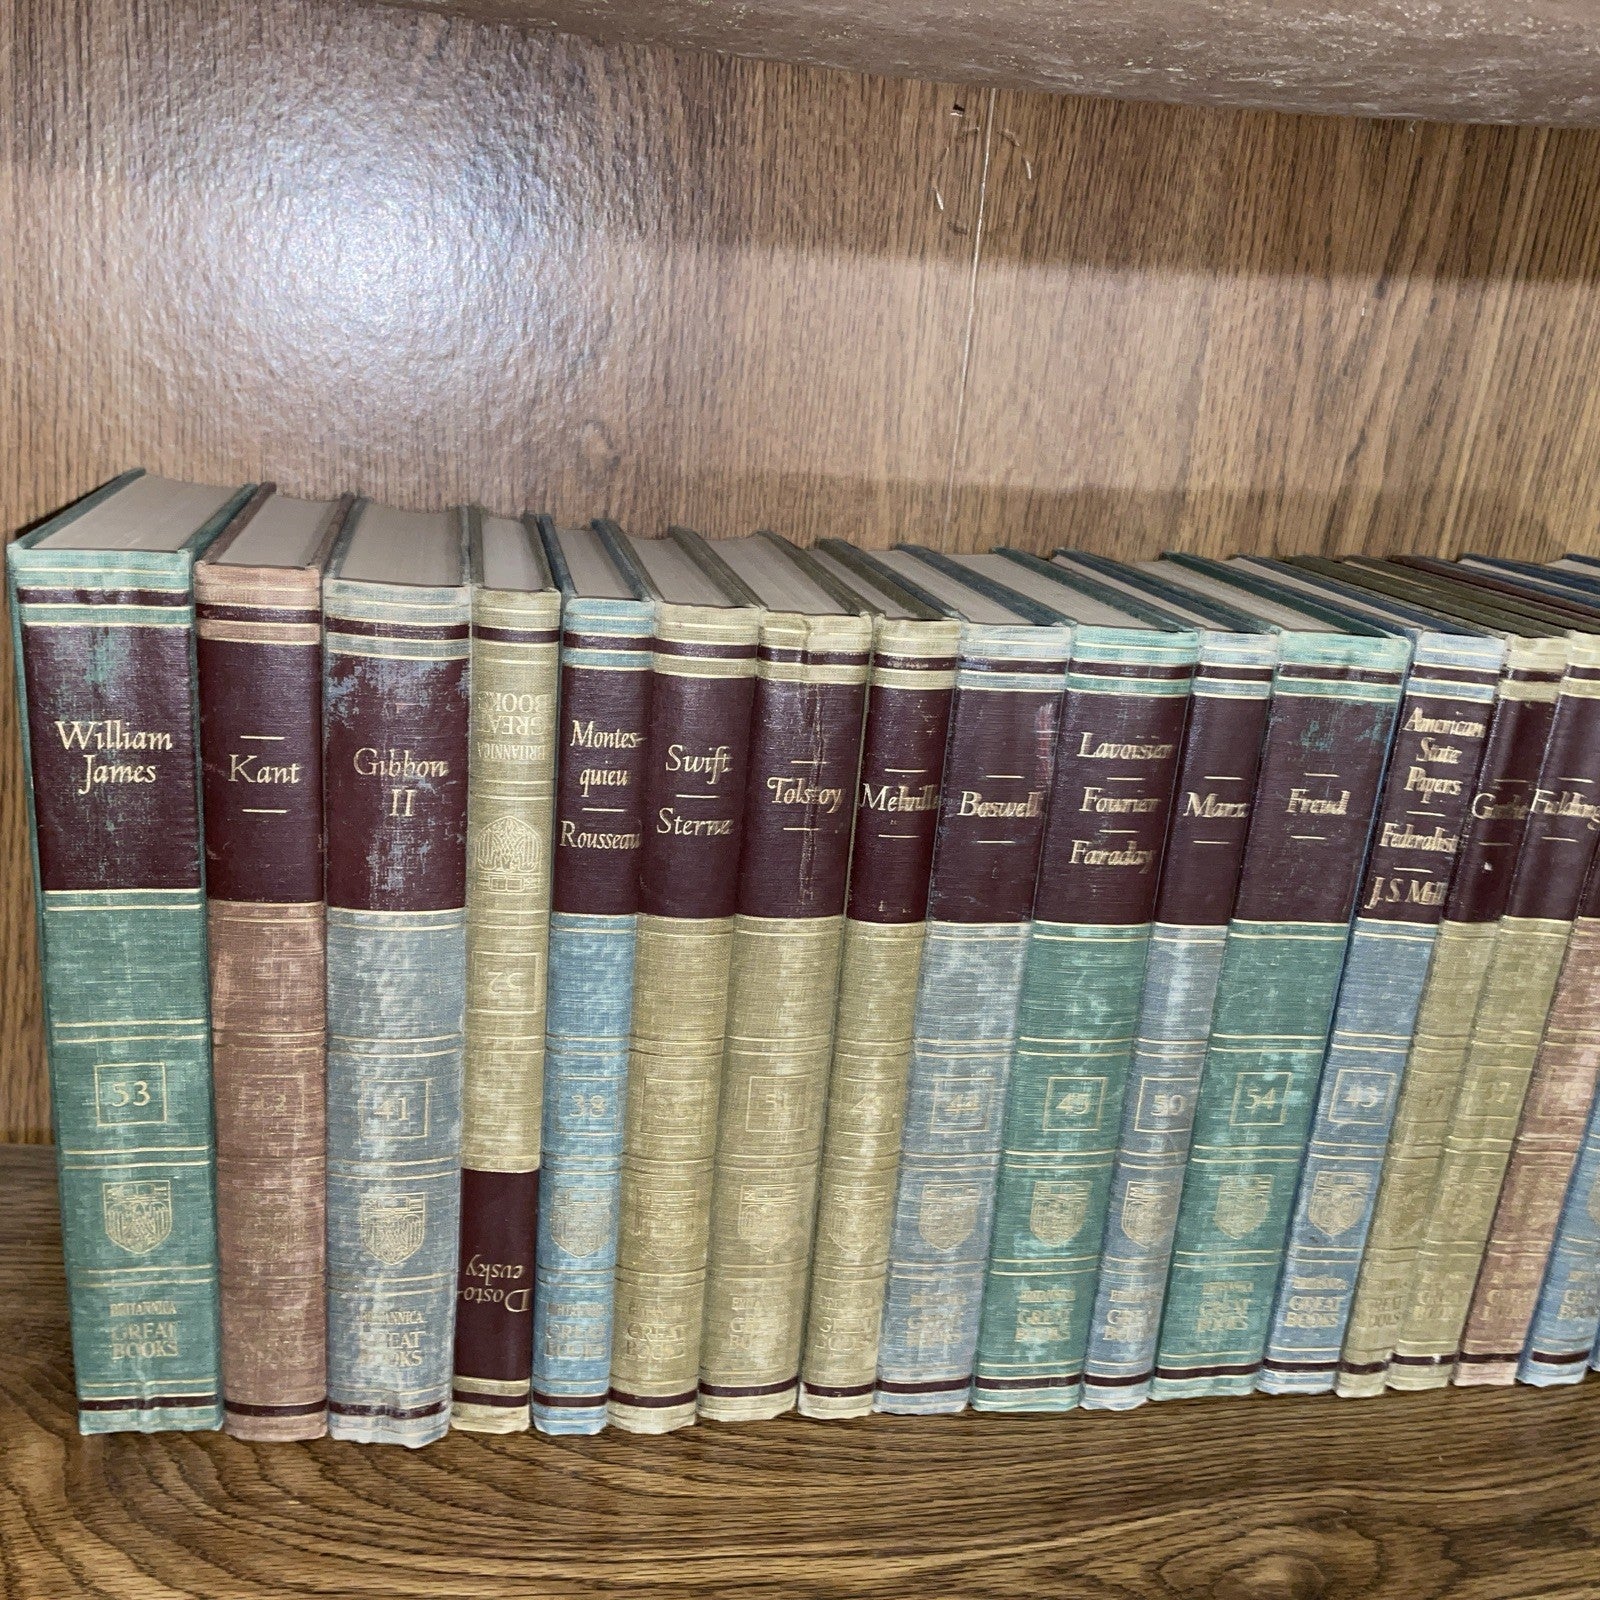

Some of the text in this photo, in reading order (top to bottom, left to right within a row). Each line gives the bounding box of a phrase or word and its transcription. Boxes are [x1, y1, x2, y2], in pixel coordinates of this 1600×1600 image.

[55, 720, 173, 751] William
[1403, 706, 1488, 738] American
[1076, 731, 1173, 760] Lavoisier
[1416, 736, 1463, 765] State
[78, 753, 157, 795] James
[228, 754, 300, 785] Kant
[353, 747, 449, 777] Gibbon
[665, 744, 734, 785] Swift
[579, 760, 630, 798] quieu
[1403, 765, 1464, 804] Papers
[389, 787, 416, 818] II
[766, 776, 843, 814] Tolstoy
[956, 790, 1045, 818] Boswell
[1079, 786, 1162, 813] Fourier
[1182, 791, 1249, 818] Marx
[1285, 788, 1352, 816] Freud
[559, 819, 642, 850] Rousseau
[656, 806, 733, 836] Sterne
[1068, 839, 1156, 875] Faraday
[112, 1081, 151, 1107] 53
[373, 1095, 409, 1121] 41
[569, 1094, 605, 1117] 38
[1150, 1094, 1188, 1116] 50
[1244, 1085, 1277, 1109] 54
[465, 1254, 525, 1286] evsky
